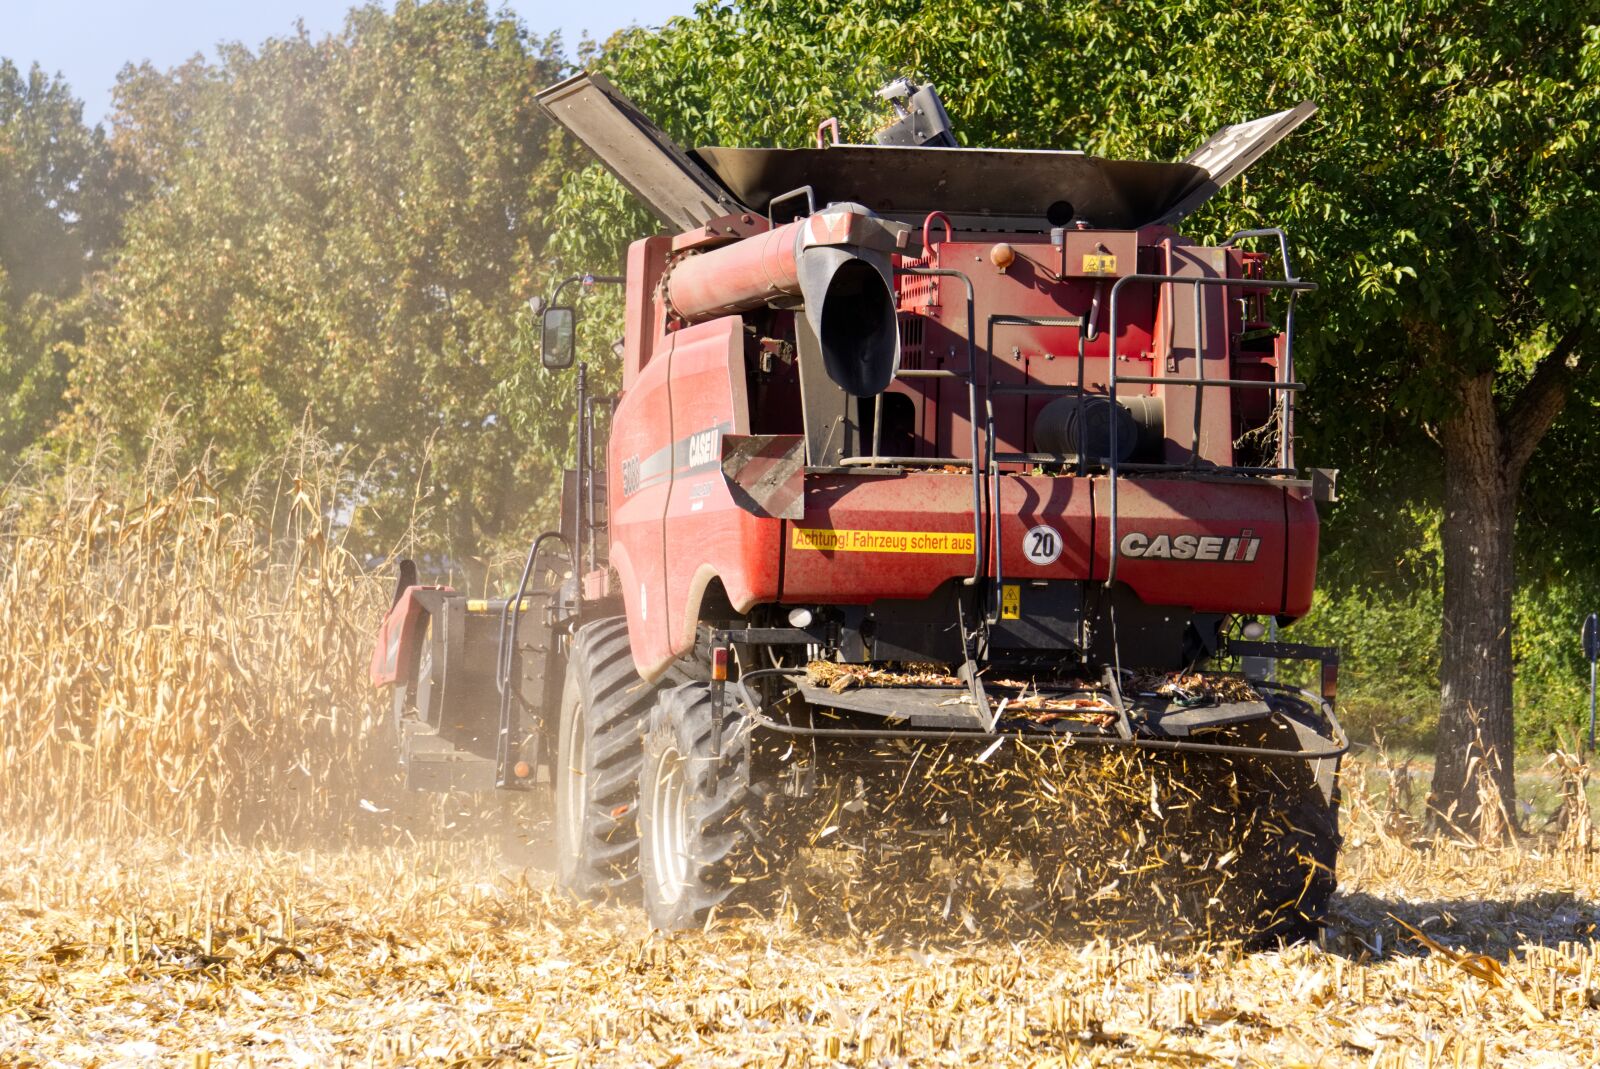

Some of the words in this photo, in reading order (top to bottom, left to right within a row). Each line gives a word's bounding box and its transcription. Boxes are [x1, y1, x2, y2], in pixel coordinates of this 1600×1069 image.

[690, 433, 710, 468] CASE
[796, 530, 849, 549] Achtung!
[853, 532, 907, 551] Fahrzeug
[911, 534, 948, 550] schert
[952, 537, 972, 550] aus
[1031, 532, 1054, 557] 20
[1120, 533, 1223, 559] CASE
